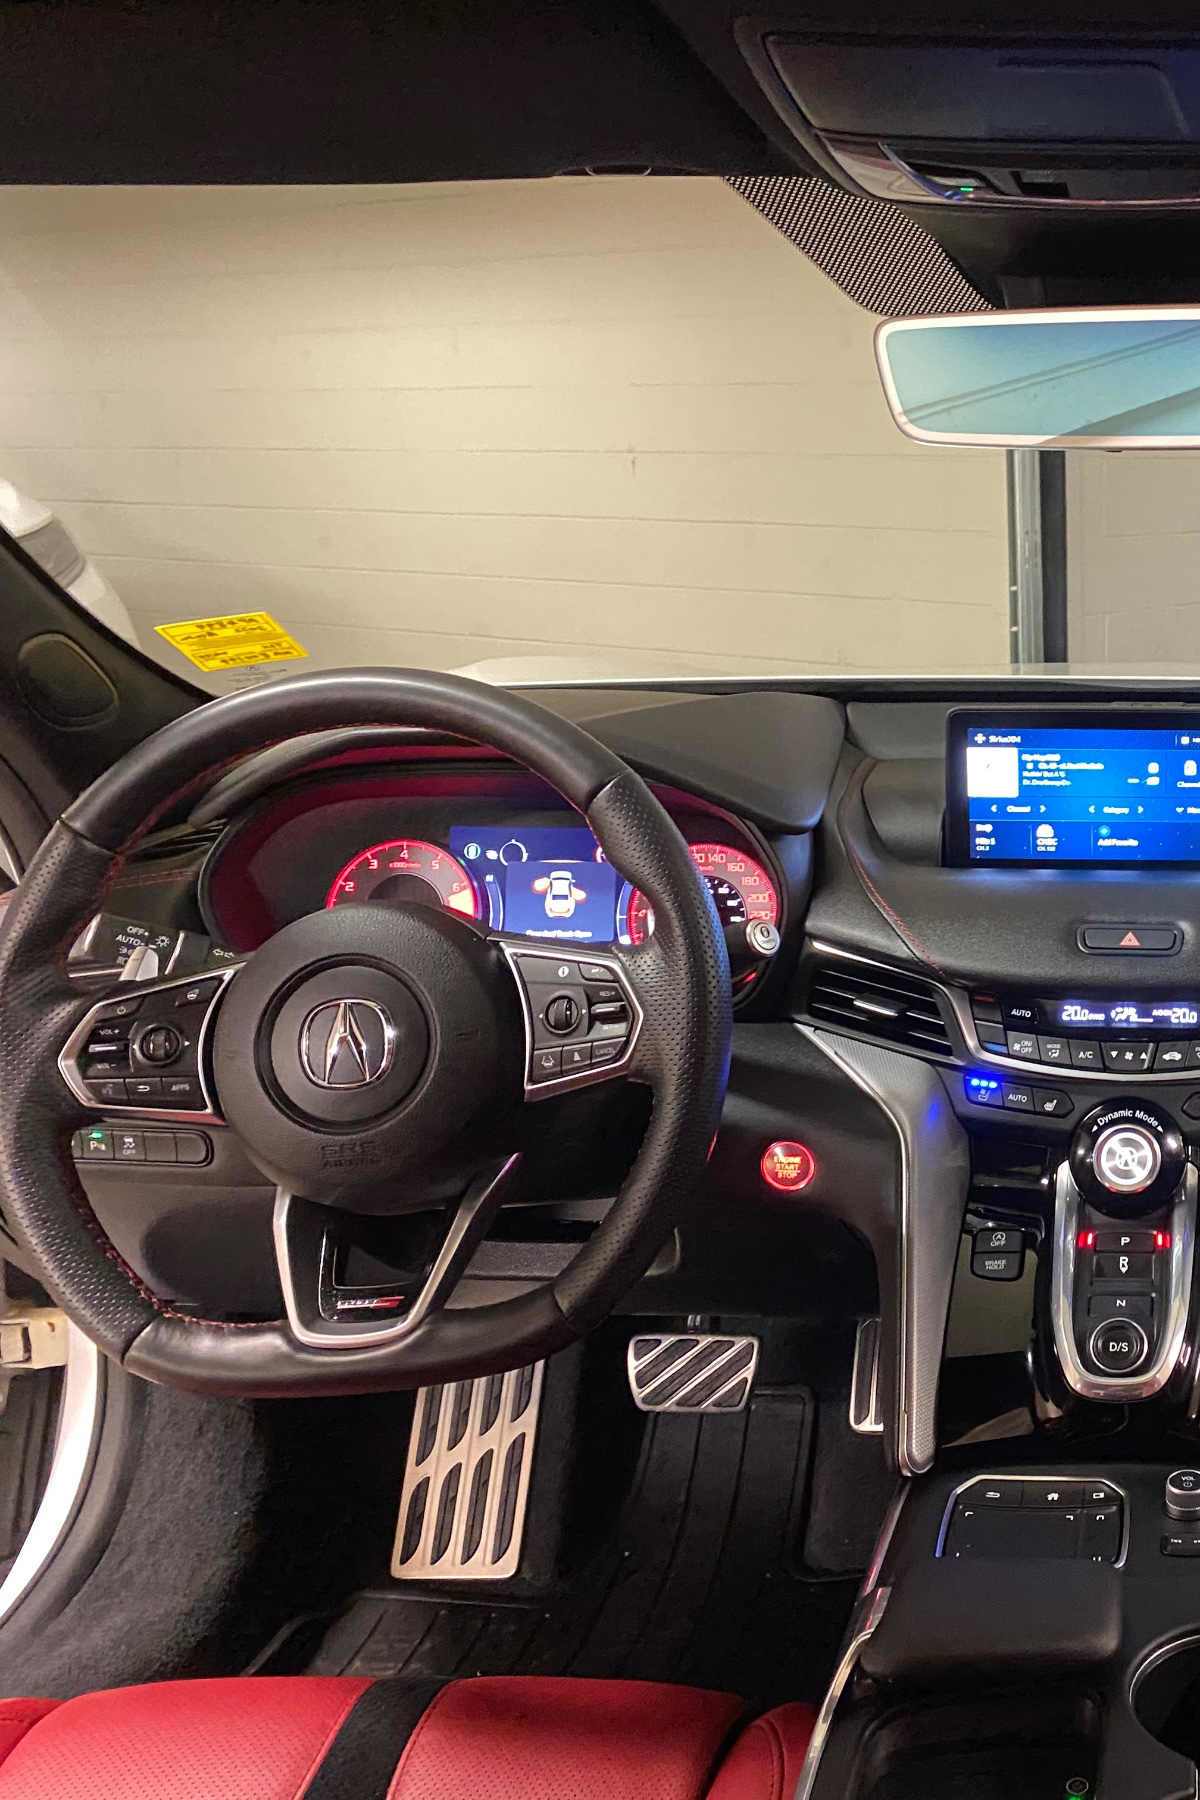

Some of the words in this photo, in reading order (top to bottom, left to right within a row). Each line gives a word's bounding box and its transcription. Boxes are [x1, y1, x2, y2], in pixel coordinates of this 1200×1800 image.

[400, 850, 409, 860] 4
[708, 854, 726, 863] 140
[368, 860, 378, 869] 3
[431, 860, 440, 870] 5
[727, 863, 745, 872] 160
[741, 877, 759, 885] 180
[344, 882, 355, 892] 2
[452, 883, 460, 891] 6
[115, 934, 141, 946] AUTO
[1011, 1008, 1032, 1018] AUTO
[1078, 1051, 1094, 1059] A/C
[1007, 1093, 1028, 1103] AUTO
[1097, 1108, 1133, 1127] Dynamic
[1134, 1109, 1160, 1128] Mode
[1120, 1237, 1131, 1246] P
[1116, 1299, 1126, 1307] N
[1109, 1341, 1129, 1352] D/S
